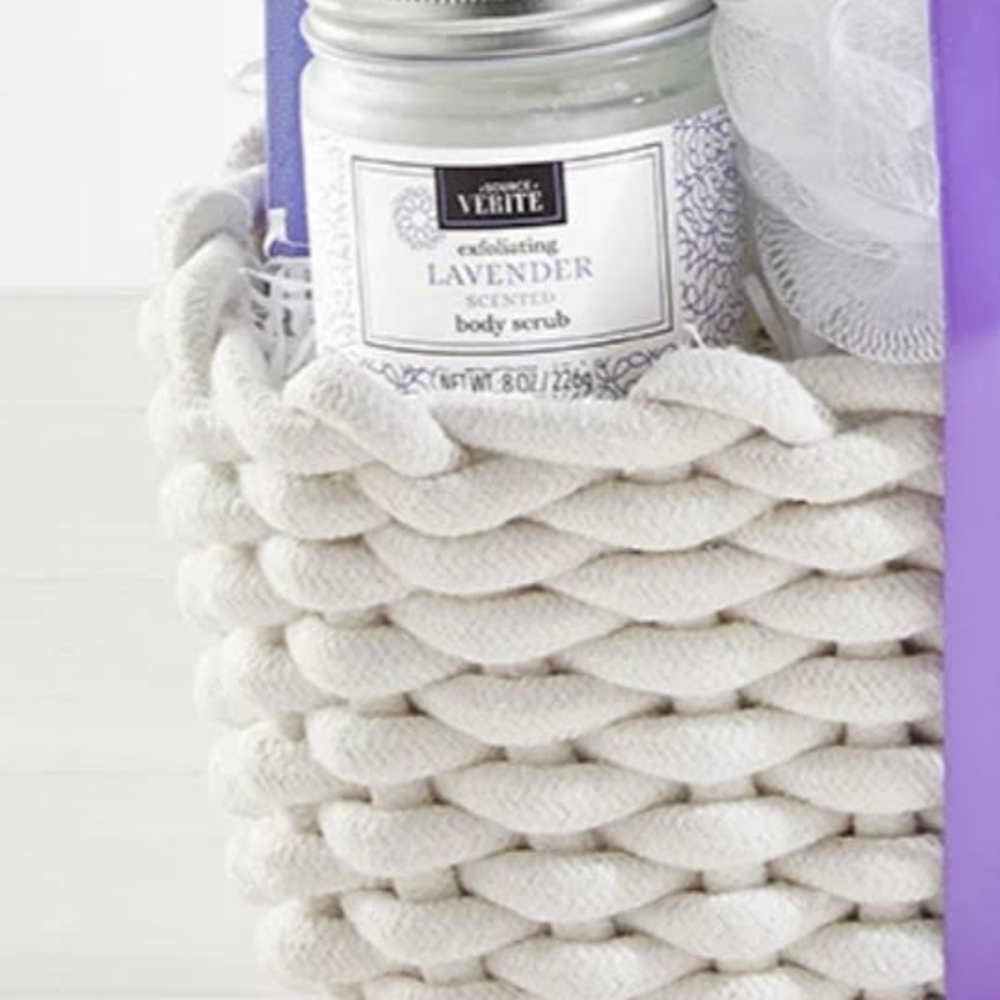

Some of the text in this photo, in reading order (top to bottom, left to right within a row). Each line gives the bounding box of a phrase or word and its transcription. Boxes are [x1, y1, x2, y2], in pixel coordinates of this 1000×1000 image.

[456, 236, 560, 257] exfoliating
[427, 256, 594, 287] LAVENDER
[465, 291, 557, 309] SCENTED
[455, 309, 571, 337] body scrub
